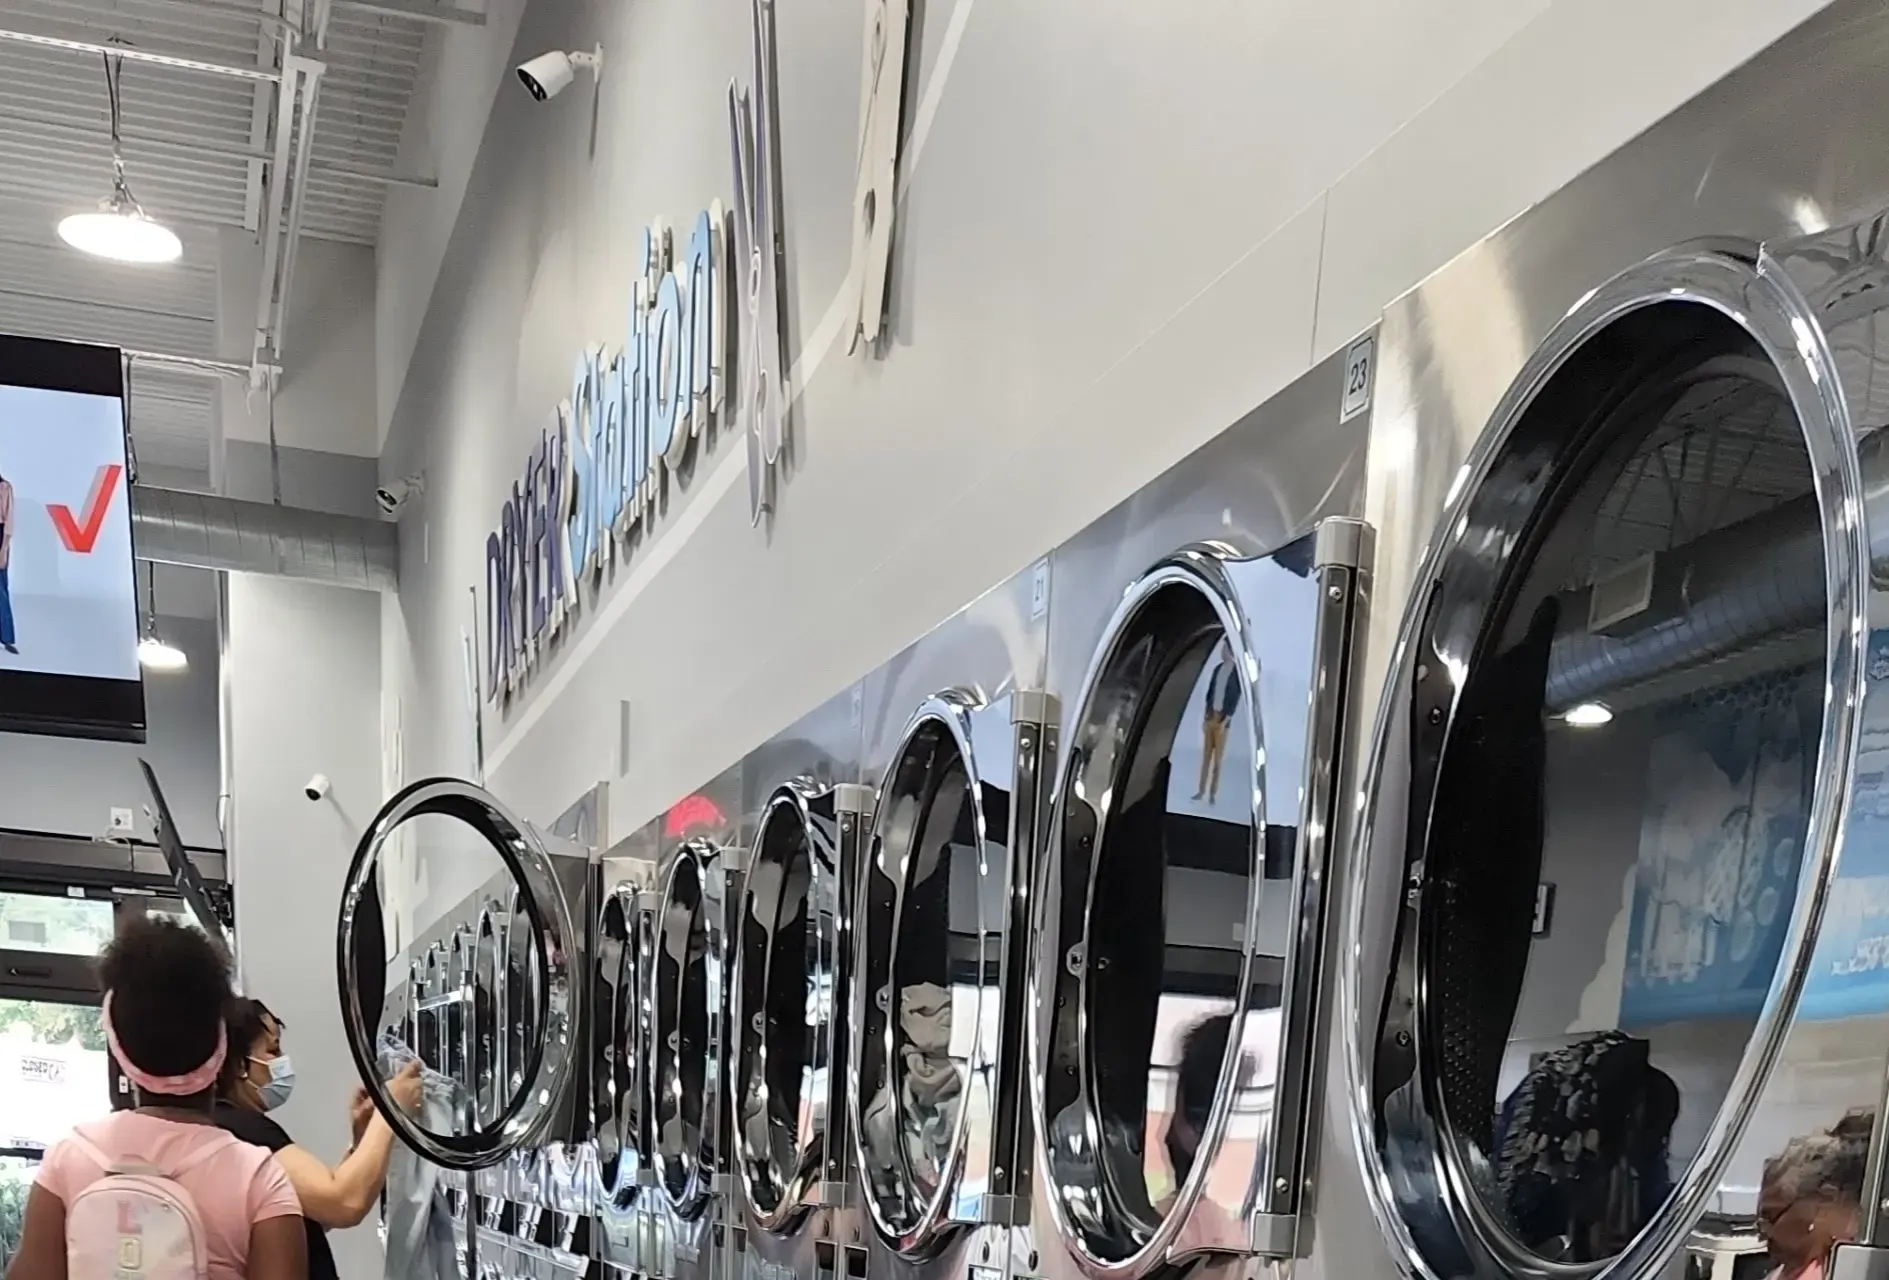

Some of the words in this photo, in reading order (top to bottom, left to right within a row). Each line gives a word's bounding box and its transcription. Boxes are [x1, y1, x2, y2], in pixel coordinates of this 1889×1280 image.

[1348, 357, 1368, 396] 23
[485, 405, 567, 698] DRYER
[568, 209, 714, 581] Station
[1035, 578, 1044, 602] 21
